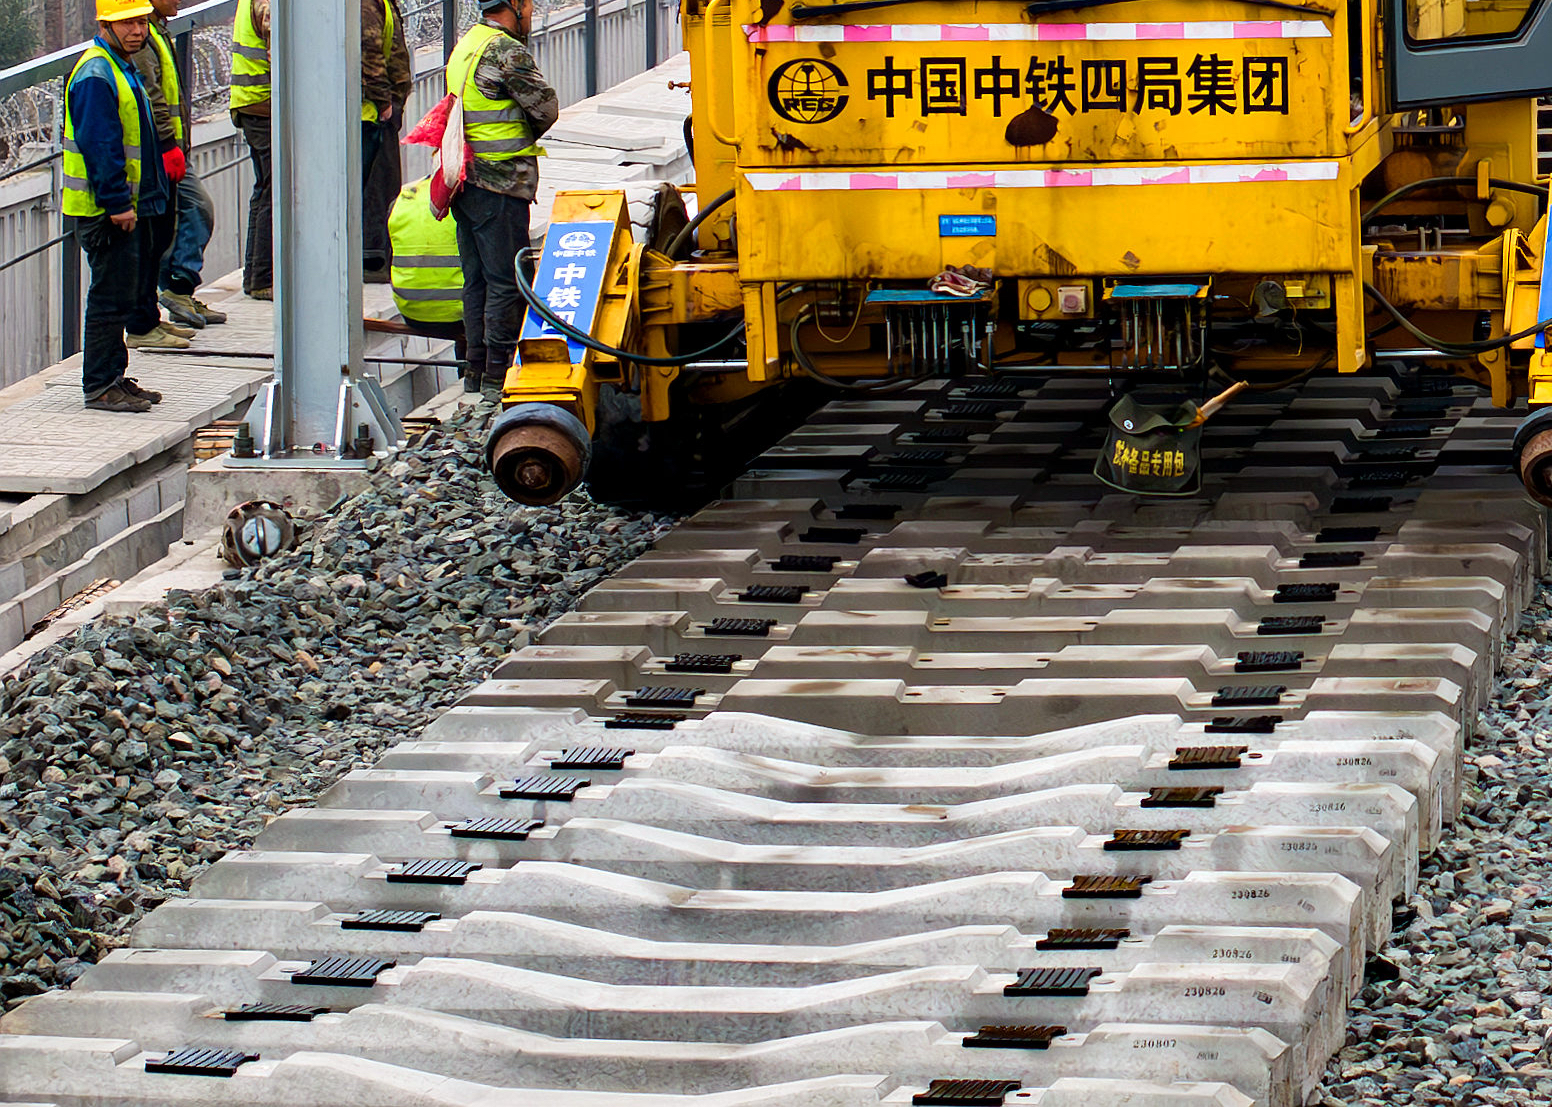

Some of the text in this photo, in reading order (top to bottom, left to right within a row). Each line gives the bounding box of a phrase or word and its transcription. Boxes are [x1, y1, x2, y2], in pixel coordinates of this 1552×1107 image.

[866, 53, 1289, 116] 中国中铁四局集团
[541, 263, 587, 341] 中铁
